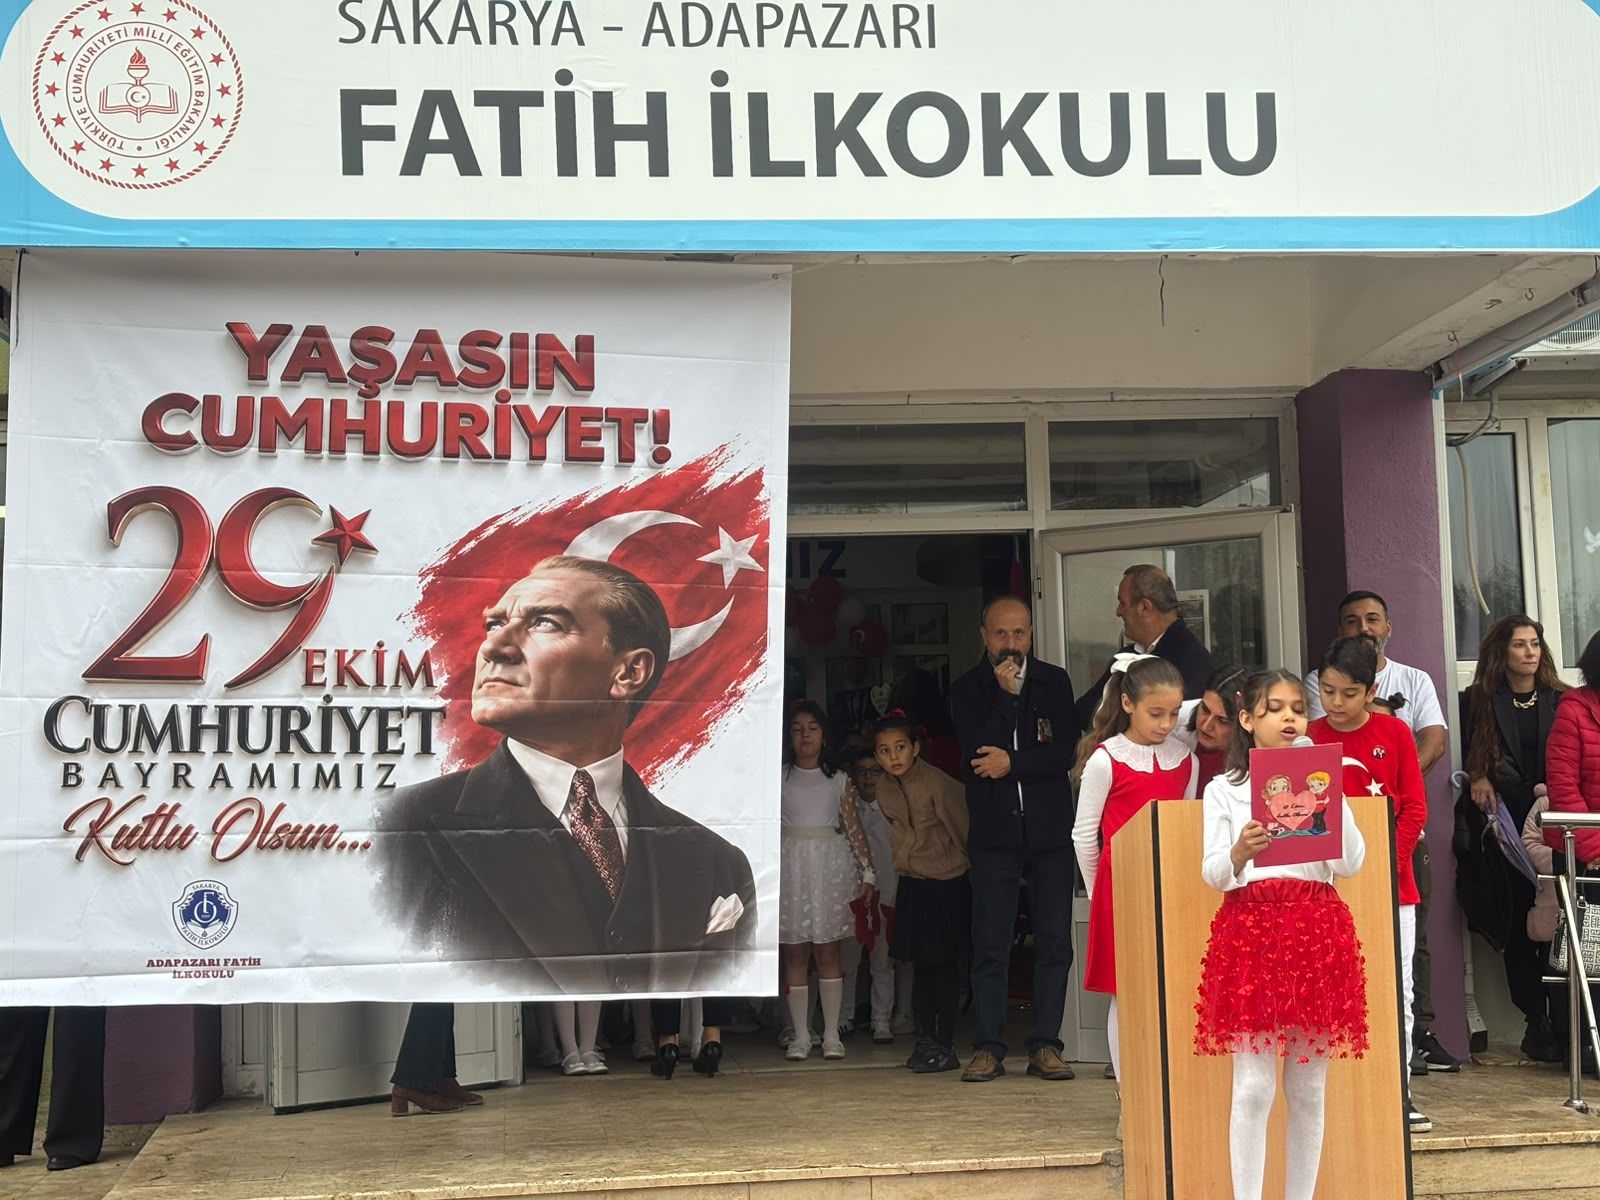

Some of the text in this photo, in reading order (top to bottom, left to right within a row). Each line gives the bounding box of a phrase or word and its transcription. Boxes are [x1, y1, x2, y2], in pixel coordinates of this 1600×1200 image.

[338, 0, 586, 46] SAKARYA
[641, 1, 937, 49] ADAPAZARI
[72, 27, 205, 151] TÜRKİYE CUMHURİYETİ MİLLİ EĞİTİM BAKANLIĞI
[339, 68, 1278, 178] FATİH İLKOKULU
[225, 321, 595, 398] YAŞASIN
[141, 388, 673, 467] CUMHURİYET!
[82, 486, 336, 691] 29
[302, 640, 438, 688] EKİM
[43, 693, 446, 756] CUMHURİYET
[61, 761, 397, 789] BAYRAMIMIZ
[63, 794, 373, 866] Kutlu Olsun...
[146, 956, 261, 968] ADAPAZARI FATİH
[172, 969, 235, 979] İLKOKULU
